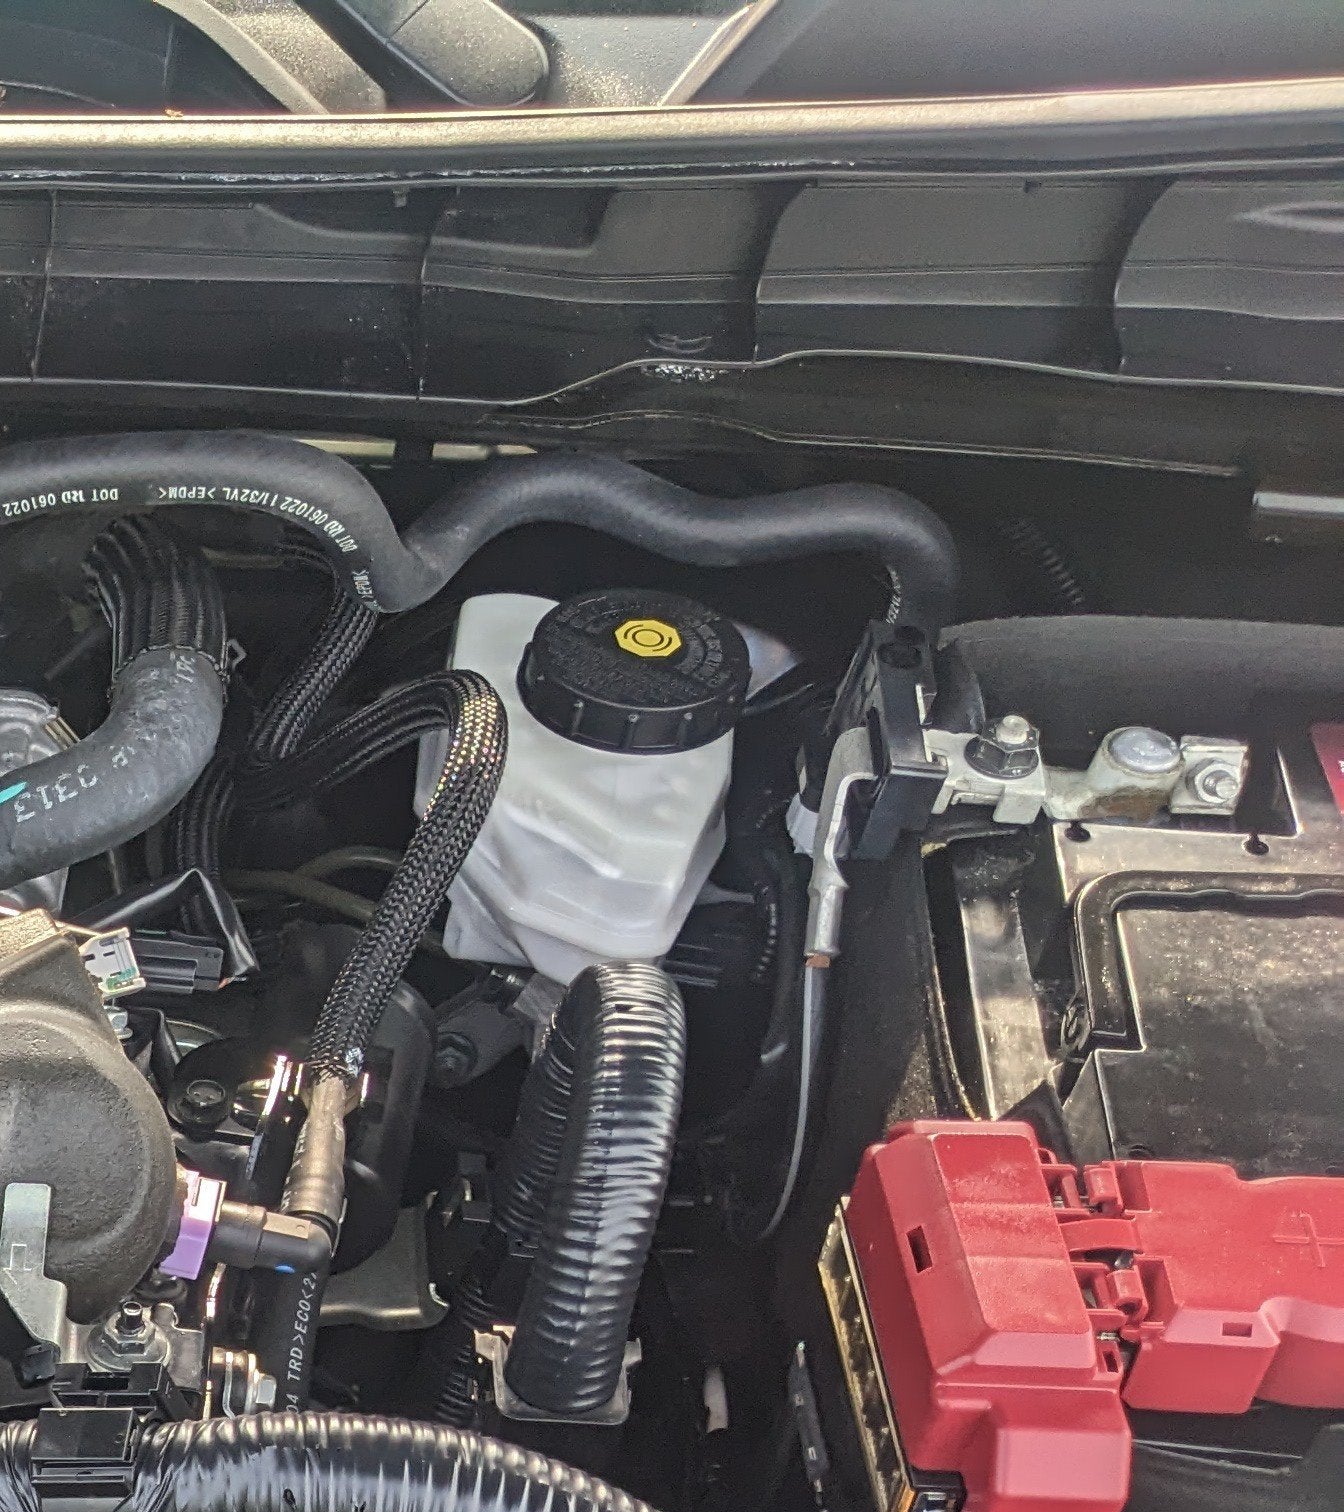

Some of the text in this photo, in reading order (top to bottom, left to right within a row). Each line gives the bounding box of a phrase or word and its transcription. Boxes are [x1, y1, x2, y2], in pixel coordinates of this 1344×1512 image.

[2, 493, 57, 518] 061022
[91, 488, 119, 502] DOT
[279, 496, 328, 526] 061022
